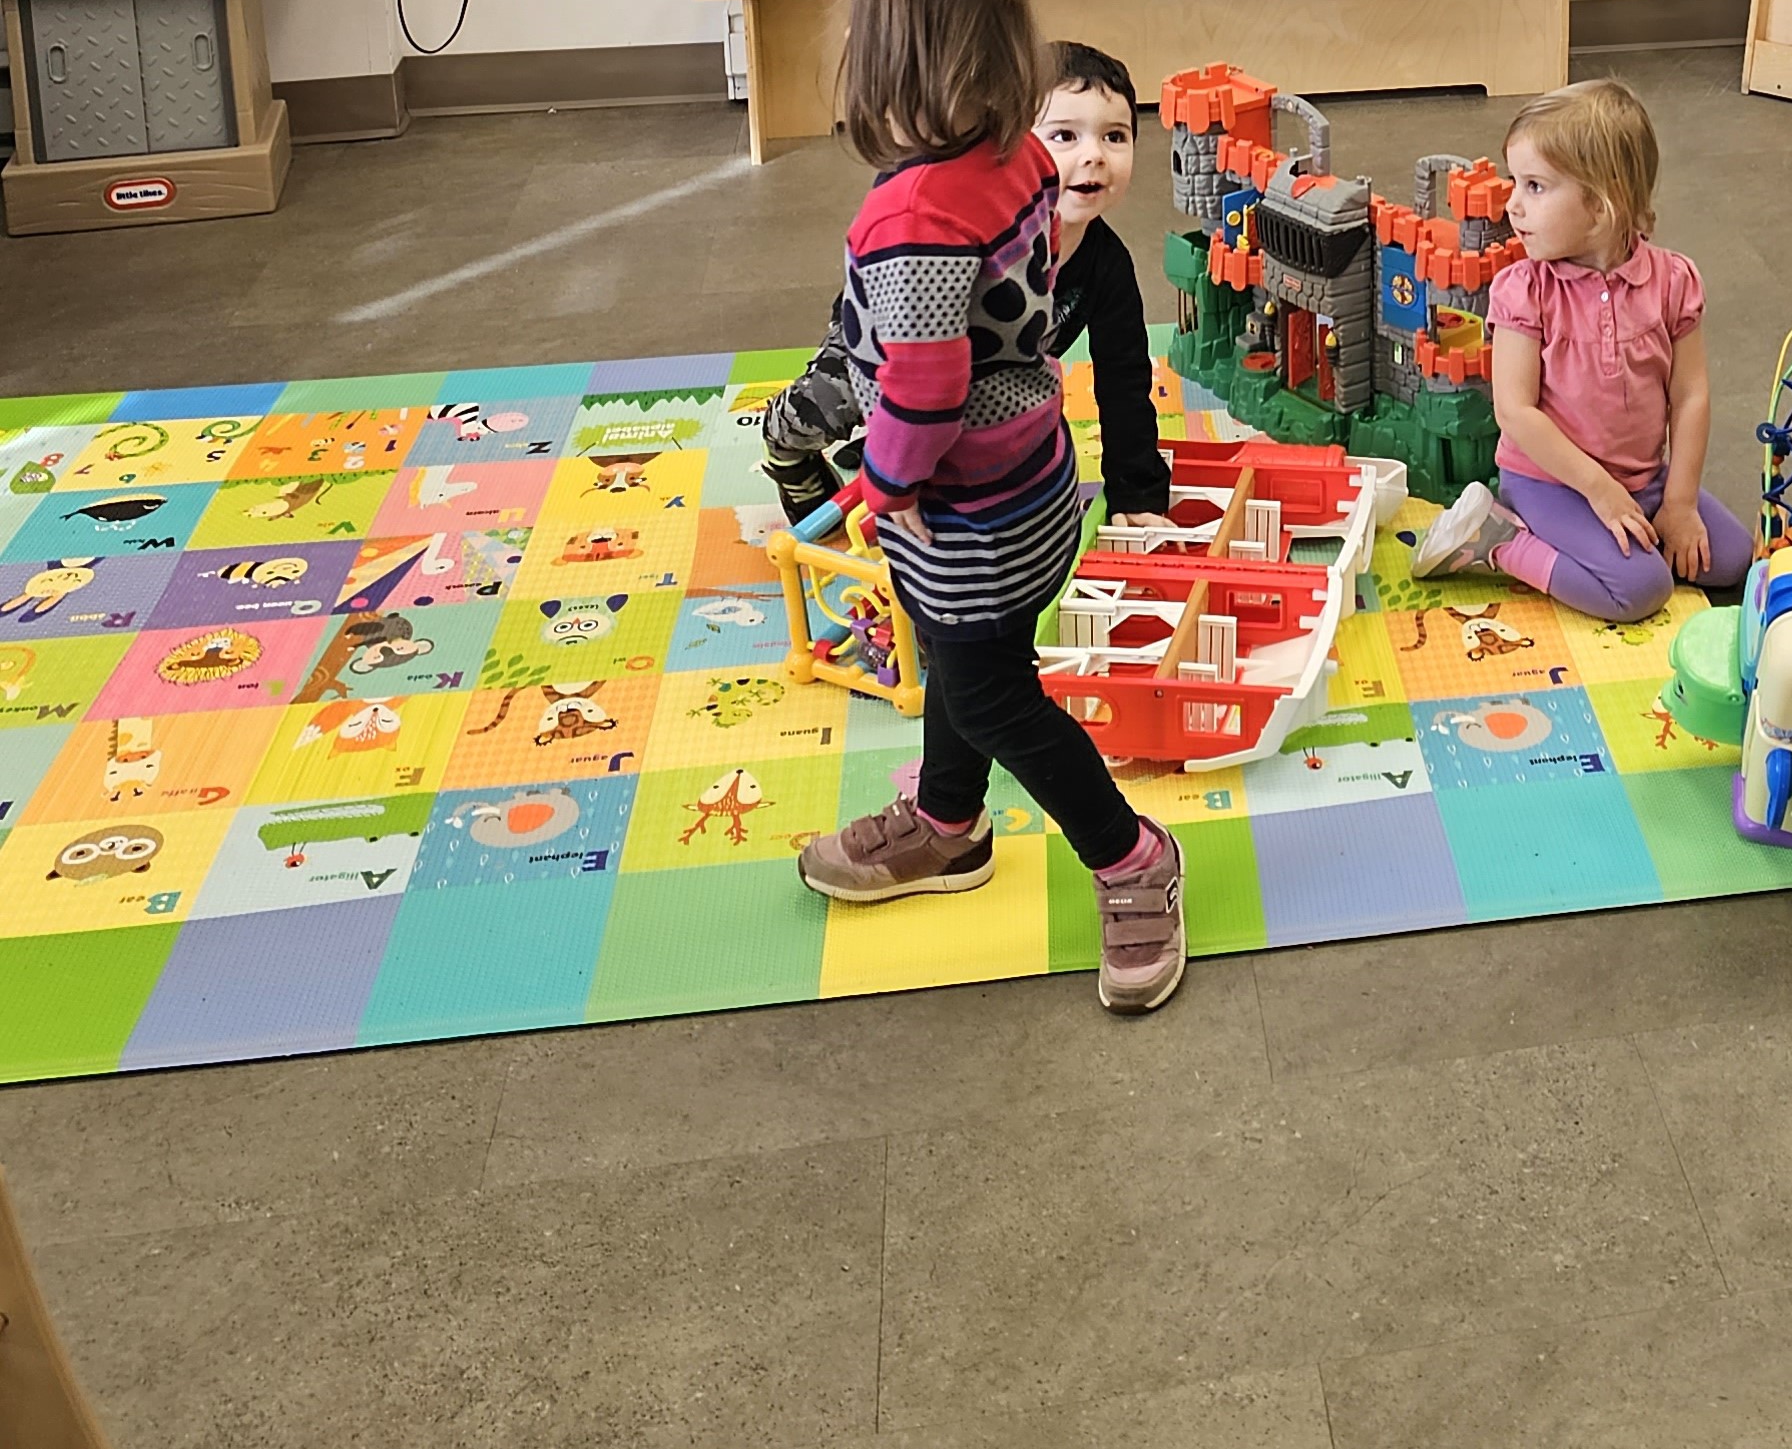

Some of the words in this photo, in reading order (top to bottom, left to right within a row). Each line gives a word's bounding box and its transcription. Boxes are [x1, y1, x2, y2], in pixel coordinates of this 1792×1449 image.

[602, 428, 675, 444] Animal
[39, 453, 65, 469] 8
[307, 449, 329, 462] 3
[263, 599, 322, 616] Queen
[613, 655, 656, 672] Owl
[407, 671, 465, 690] Koala
[1512, 666, 1569, 685] Jaguar
[1354, 679, 1387, 699] Fox
[780, 726, 833, 746] Iguana
[570, 752, 635, 773] Jaguar
[1529, 753, 1607, 774] Elephant
[394, 766, 426, 787] Fox
[1337, 770, 1414, 790] Alligator
[1178, 789, 1233, 811] Bear
[529, 848, 610, 873] Elephant
[308, 868, 399, 890] Alligator
[119, 890, 182, 915] Bear
